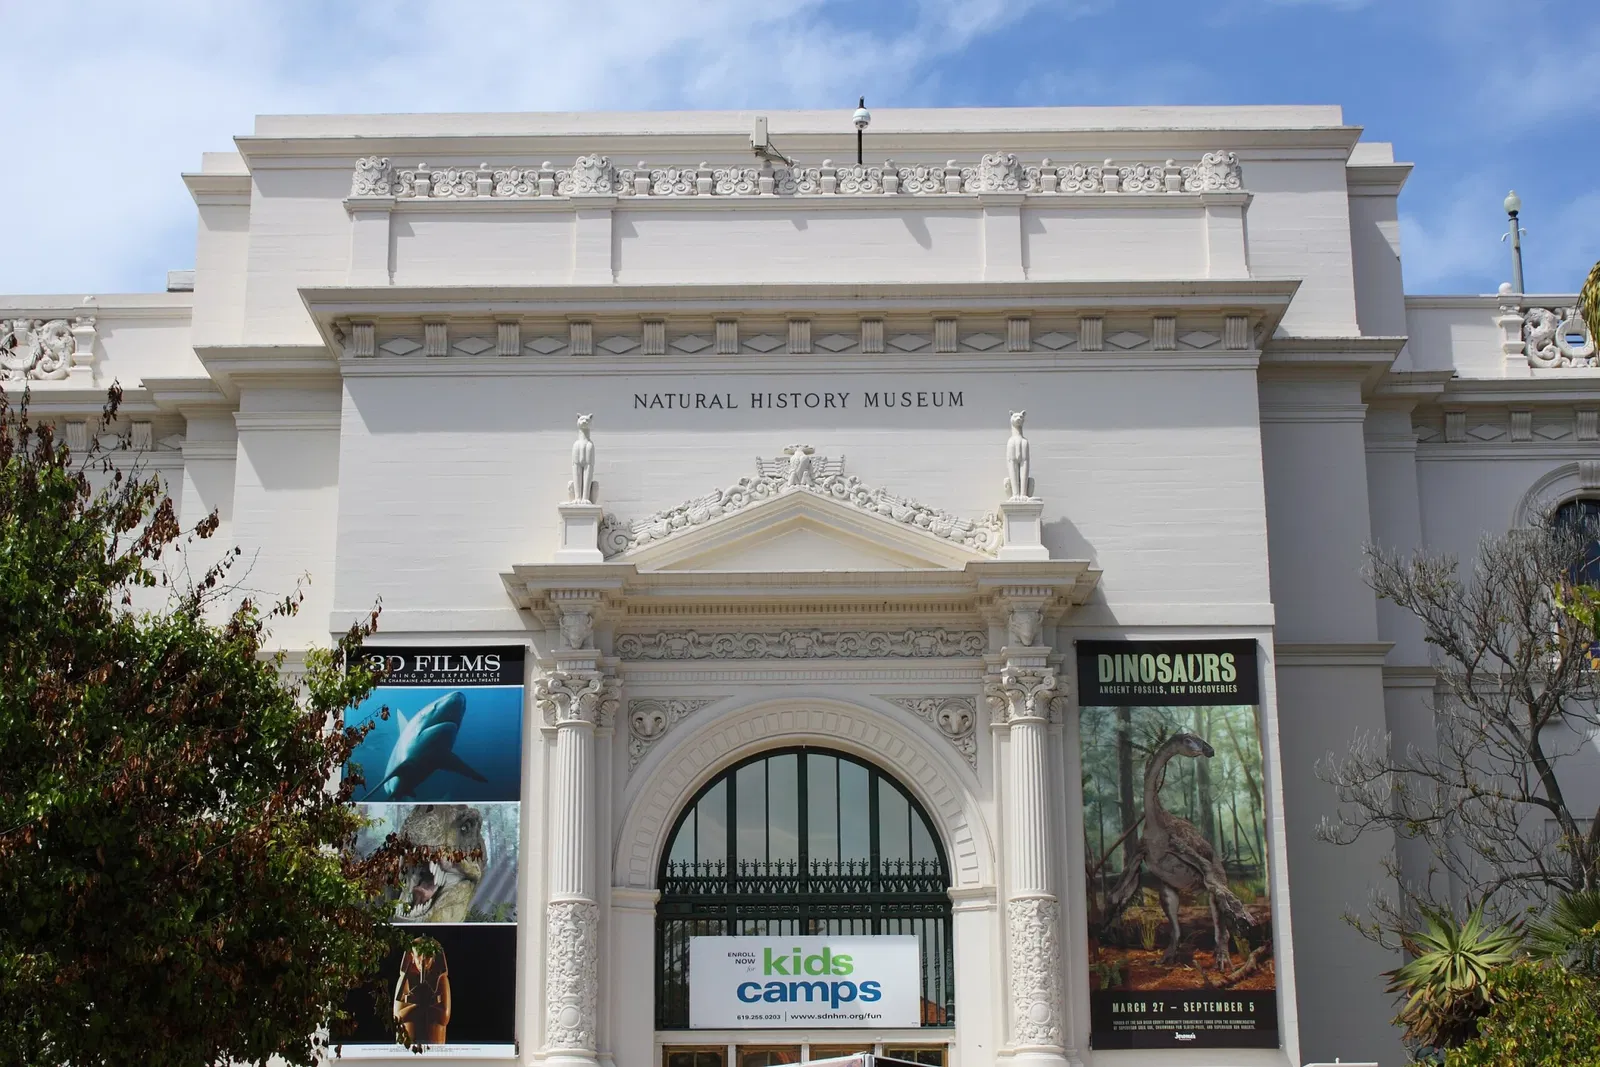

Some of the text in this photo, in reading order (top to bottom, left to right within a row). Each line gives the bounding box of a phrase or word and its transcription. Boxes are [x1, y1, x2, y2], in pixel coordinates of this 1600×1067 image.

[633, 391, 964, 409] NATURAL HISTORY MUSEUM
[370, 655, 501, 671] 3D FILMS
[1098, 653, 1237, 683] DINOSAURS
[1100, 684, 1238, 695] ANCIENT FOSSILS, NEW DISCOVERIES
[764, 947, 854, 976] kids
[737, 980, 882, 1009] camps
[1112, 1002, 1146, 1013] MARCH
[1153, 1002, 1164, 1012] 27
[1183, 1001, 1243, 1012] SEPTEMBER
[1249, 1001, 1255, 1012] 5
[790, 1012, 882, 1020] www.sdnhm.org/fun
